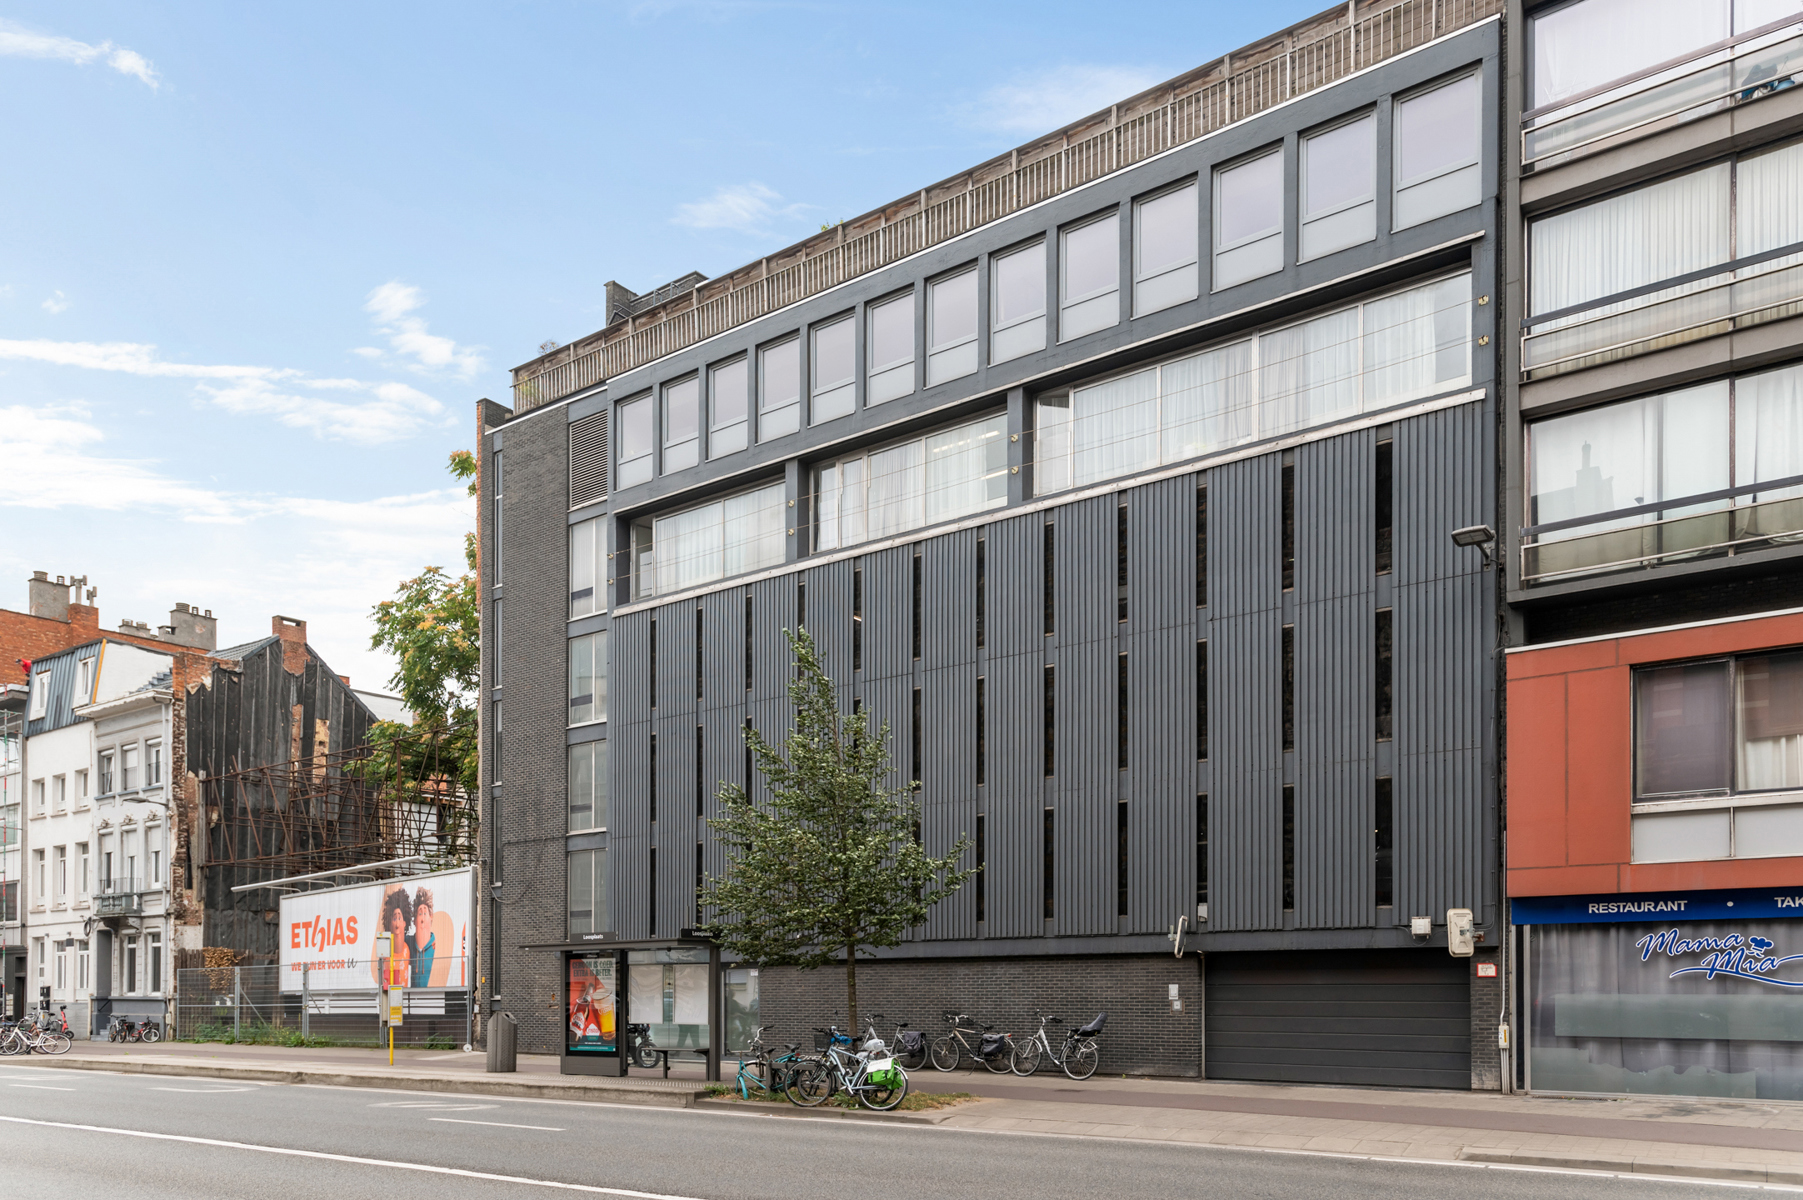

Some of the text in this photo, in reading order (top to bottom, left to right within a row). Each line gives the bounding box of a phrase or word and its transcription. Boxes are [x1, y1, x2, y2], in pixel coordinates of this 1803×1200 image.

[1588, 896, 1803, 914] RESTAURANT TAK
[1636, 928, 1744, 961] Mama
[291, 961, 301, 972] WE
[318, 960, 325, 970] ER
[327, 959, 345, 969] VOOR
[593, 960, 598, 968] IS
[1701, 947, 1779, 980] Mia
[573, 969, 588, 977] EXTRA
